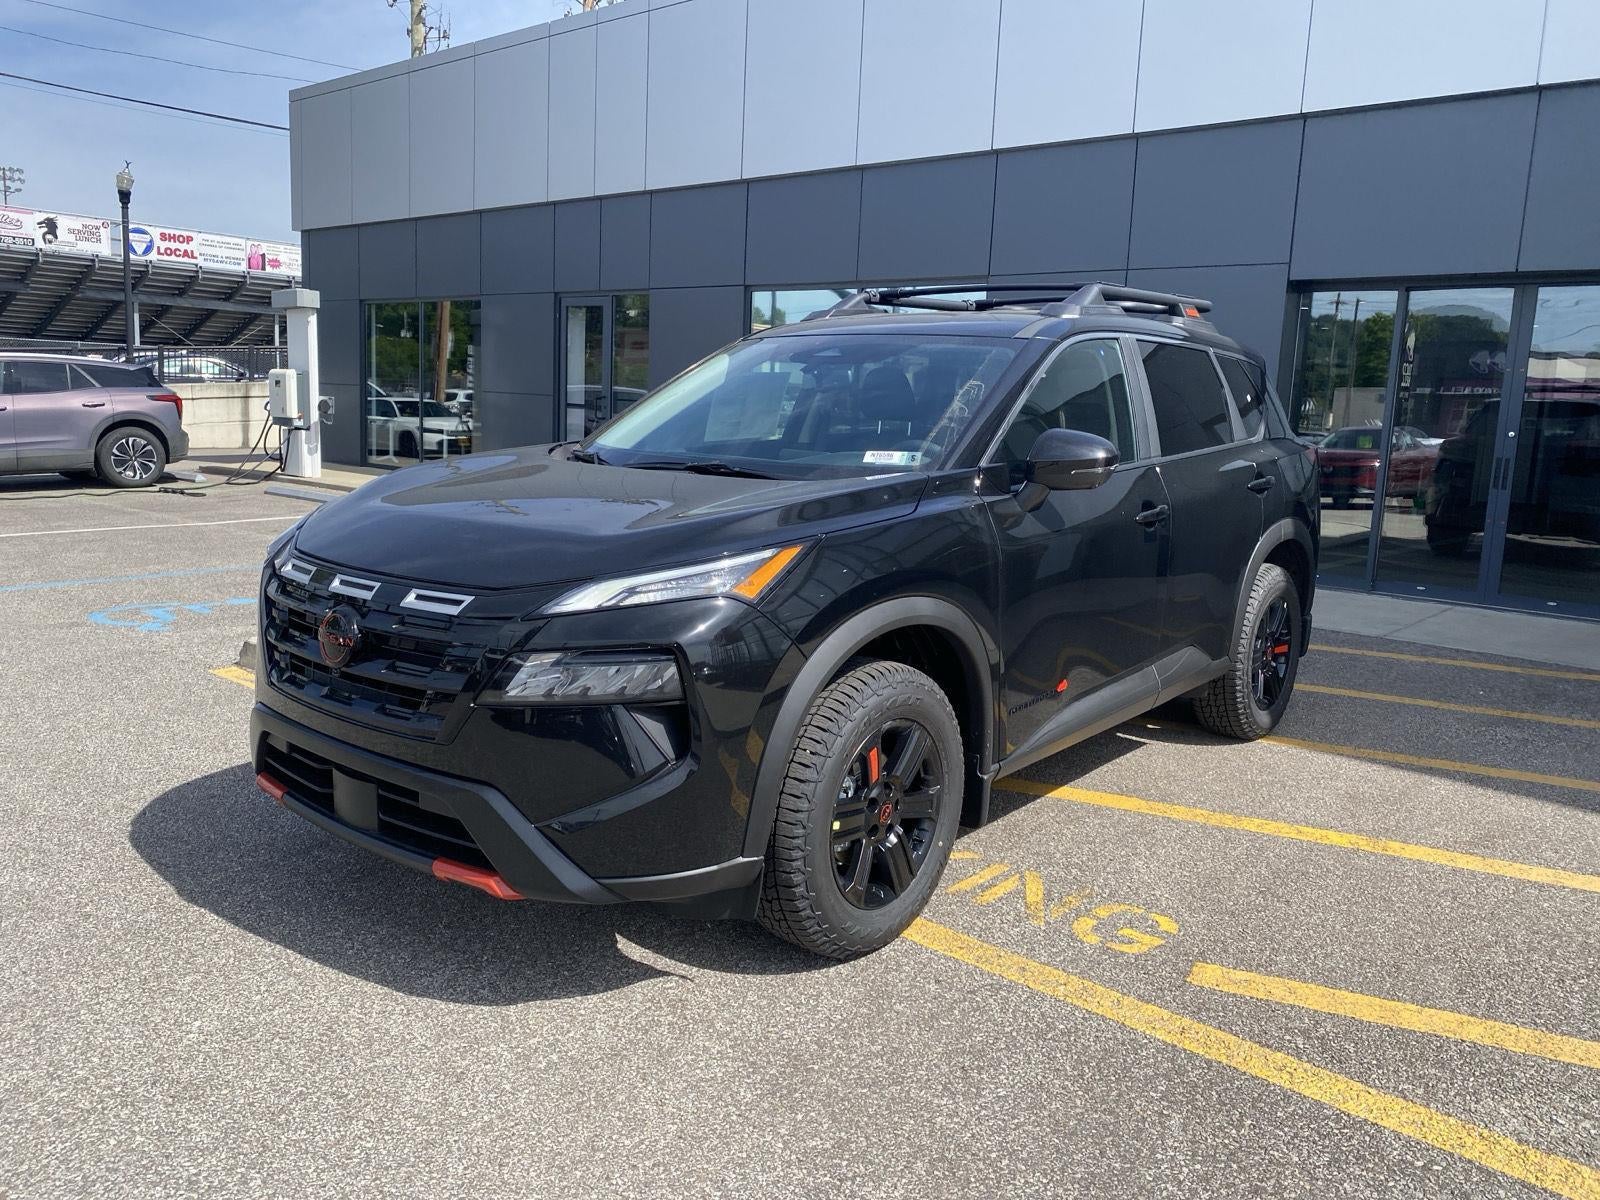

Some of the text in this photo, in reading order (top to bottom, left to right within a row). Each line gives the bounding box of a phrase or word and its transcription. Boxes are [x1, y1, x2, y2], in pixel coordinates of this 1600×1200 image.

[82, 223, 101, 231] NOW
[67, 228, 101, 238] SERVING
[159, 232, 194, 244] SHOP
[75, 235, 102, 244] LUNCH
[156, 246, 198, 260] LOCAL
